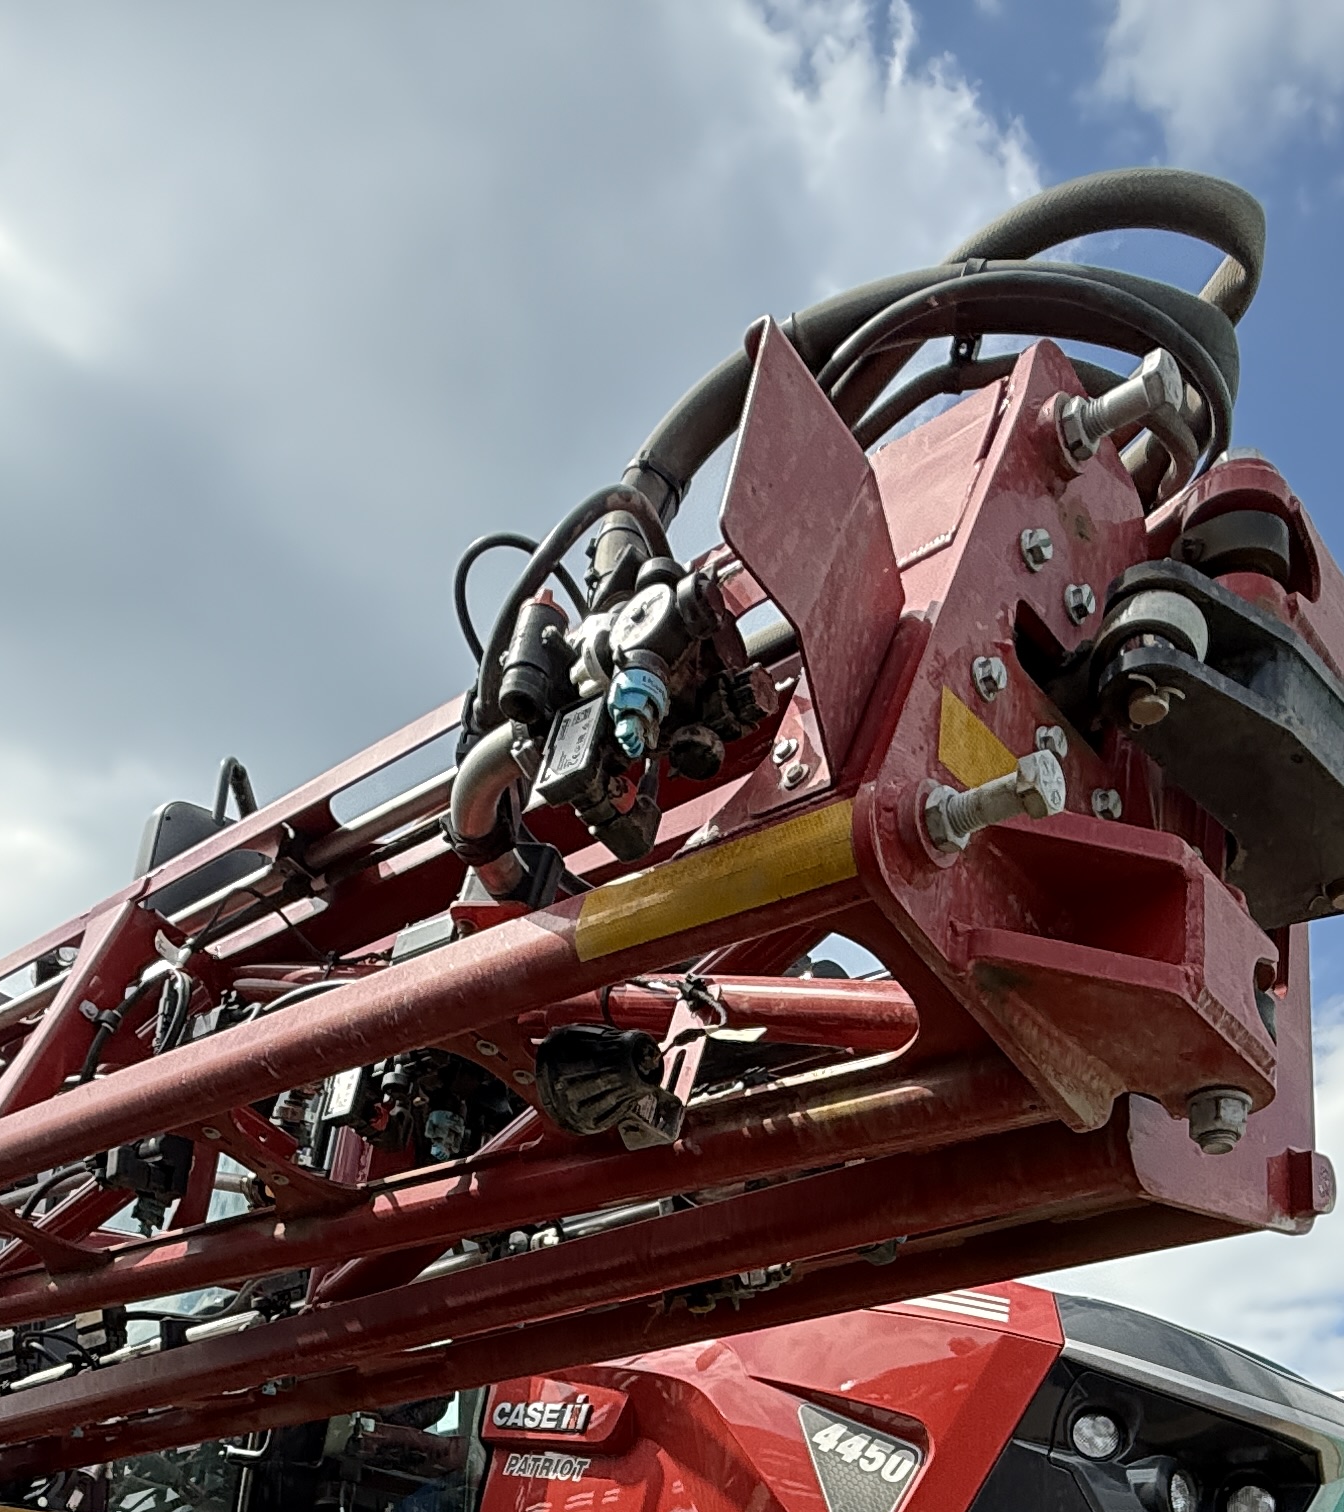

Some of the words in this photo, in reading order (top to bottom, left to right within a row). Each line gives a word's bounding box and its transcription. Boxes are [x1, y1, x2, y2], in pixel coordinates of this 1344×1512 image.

[493, 1402, 564, 1428] CASE
[502, 1453, 591, 1482] PATRIOT
[812, 1423, 916, 1483] 4450
